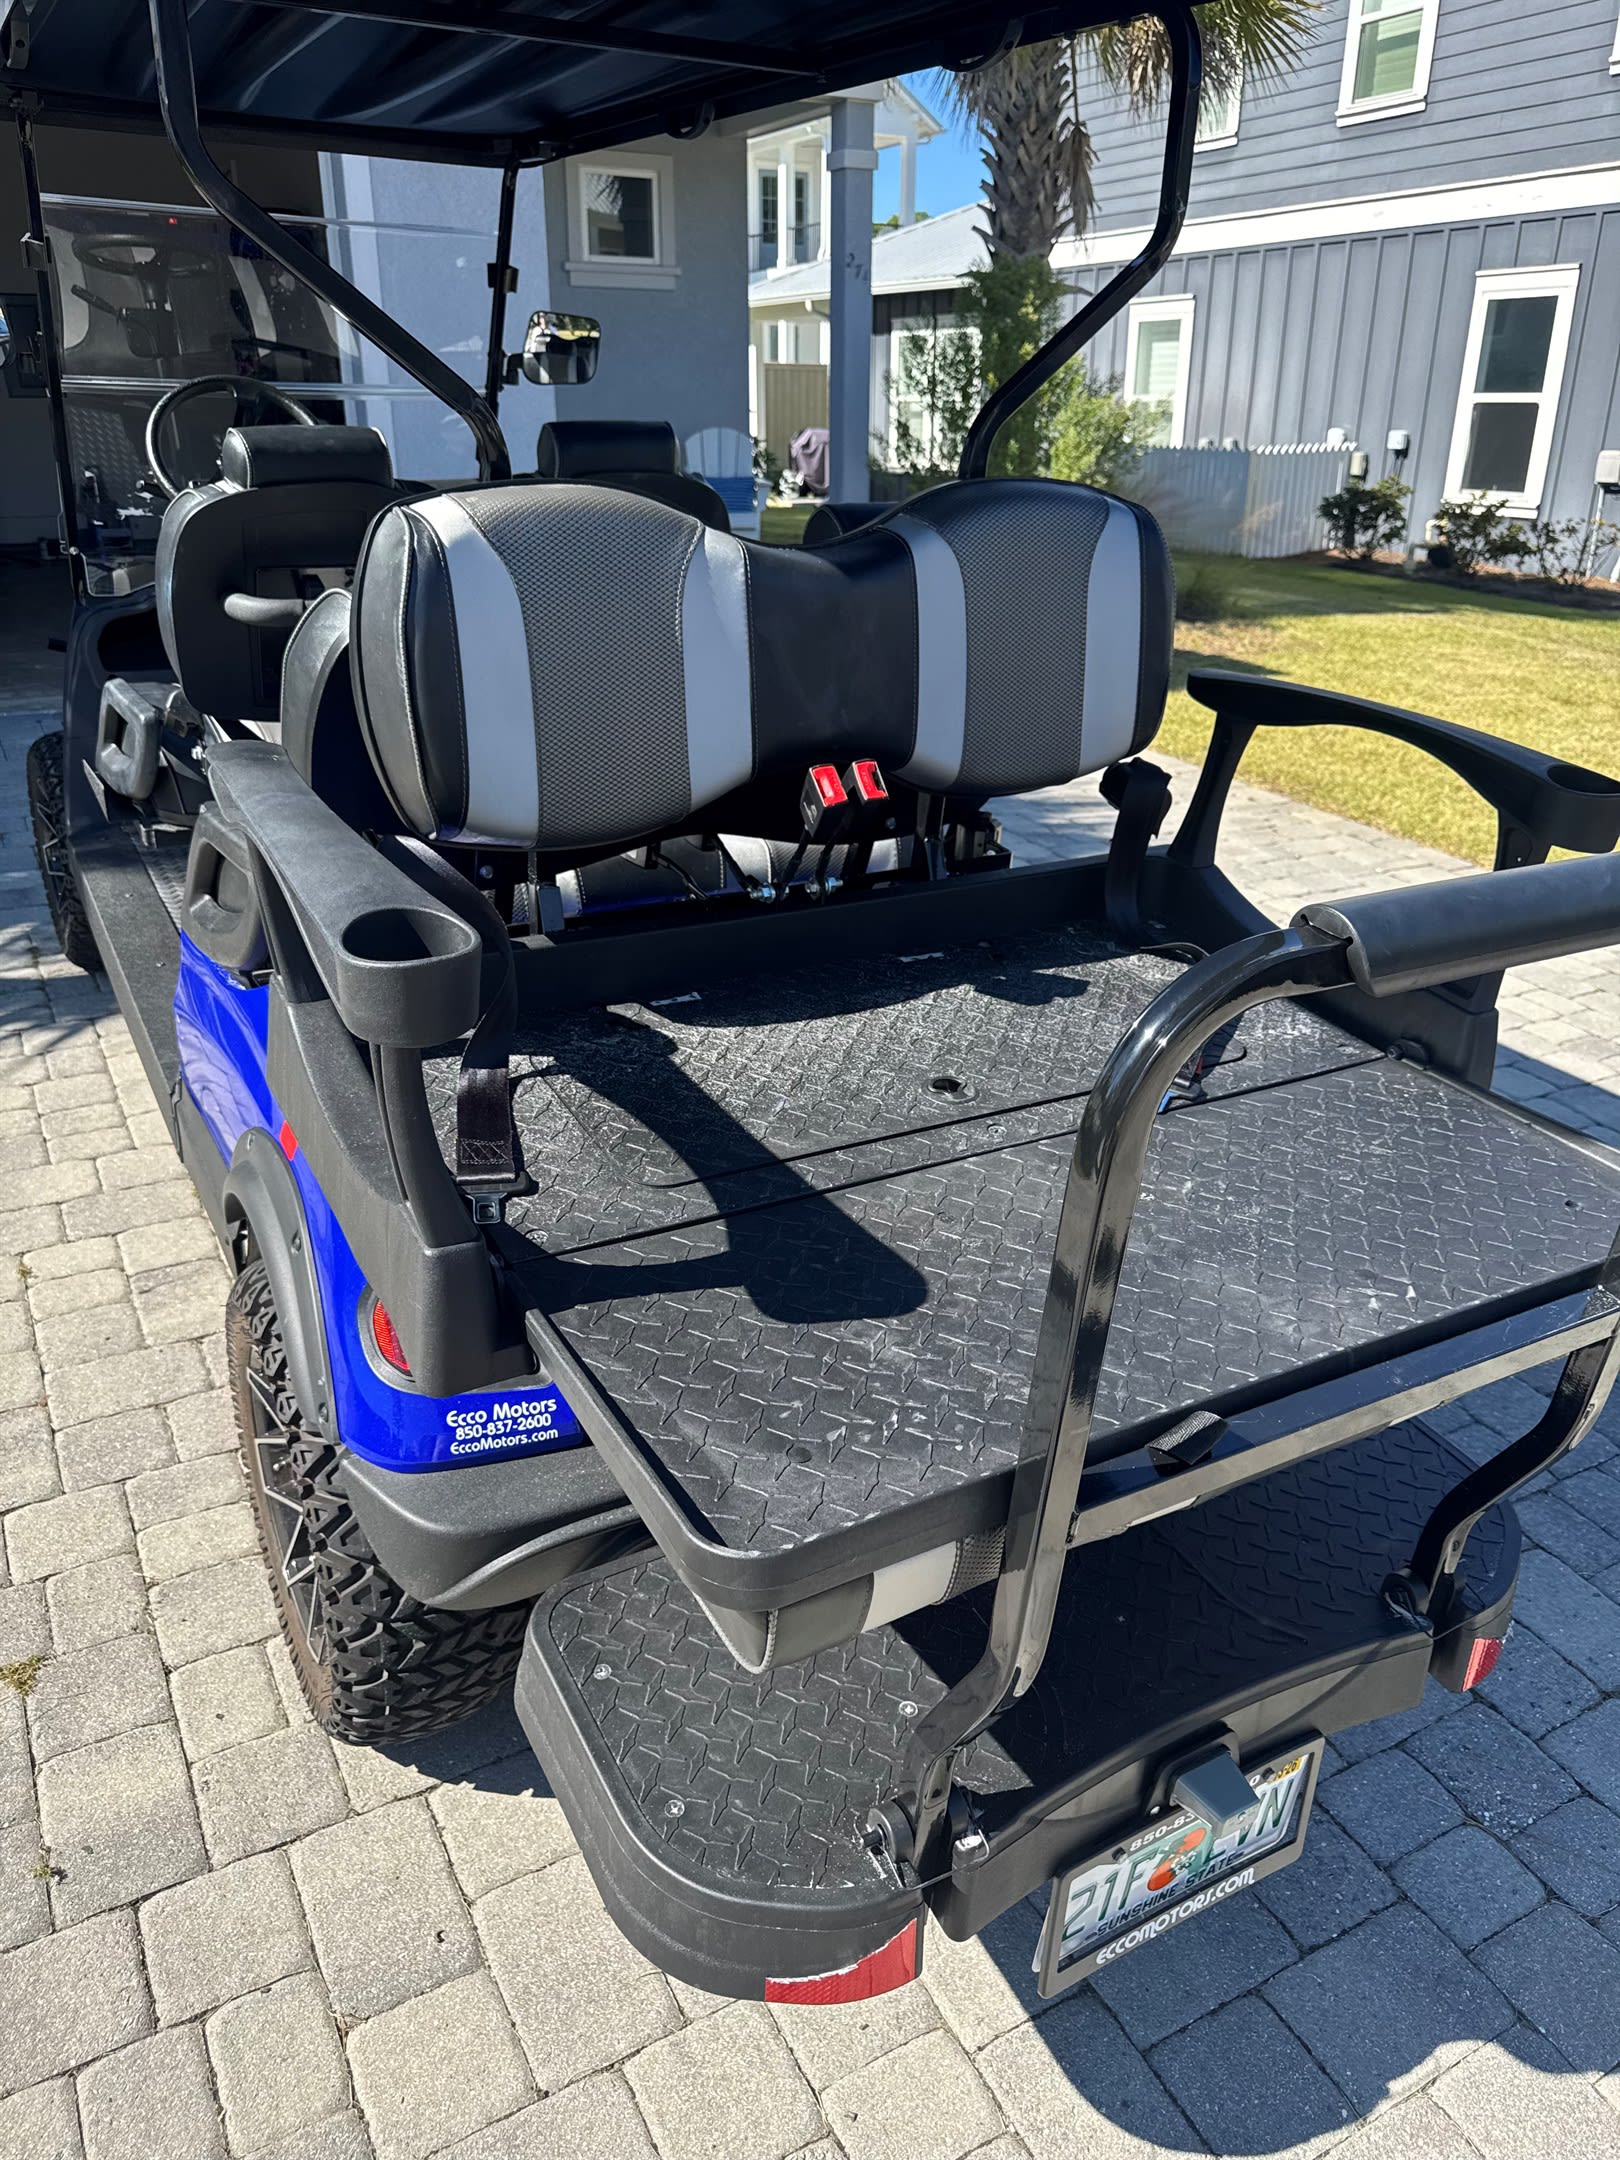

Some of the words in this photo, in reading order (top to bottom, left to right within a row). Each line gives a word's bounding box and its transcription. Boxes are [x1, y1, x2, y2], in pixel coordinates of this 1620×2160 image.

[446, 1410, 487, 1427] Ecco
[493, 1399, 558, 1421] Motors
[455, 1413, 552, 1441] 850-837-2600
[450, 1428, 559, 1455] EccoMotors.com
[1097, 1882, 1180, 1937] SUNSHINE
[1184, 1850, 1238, 1889] STATE
